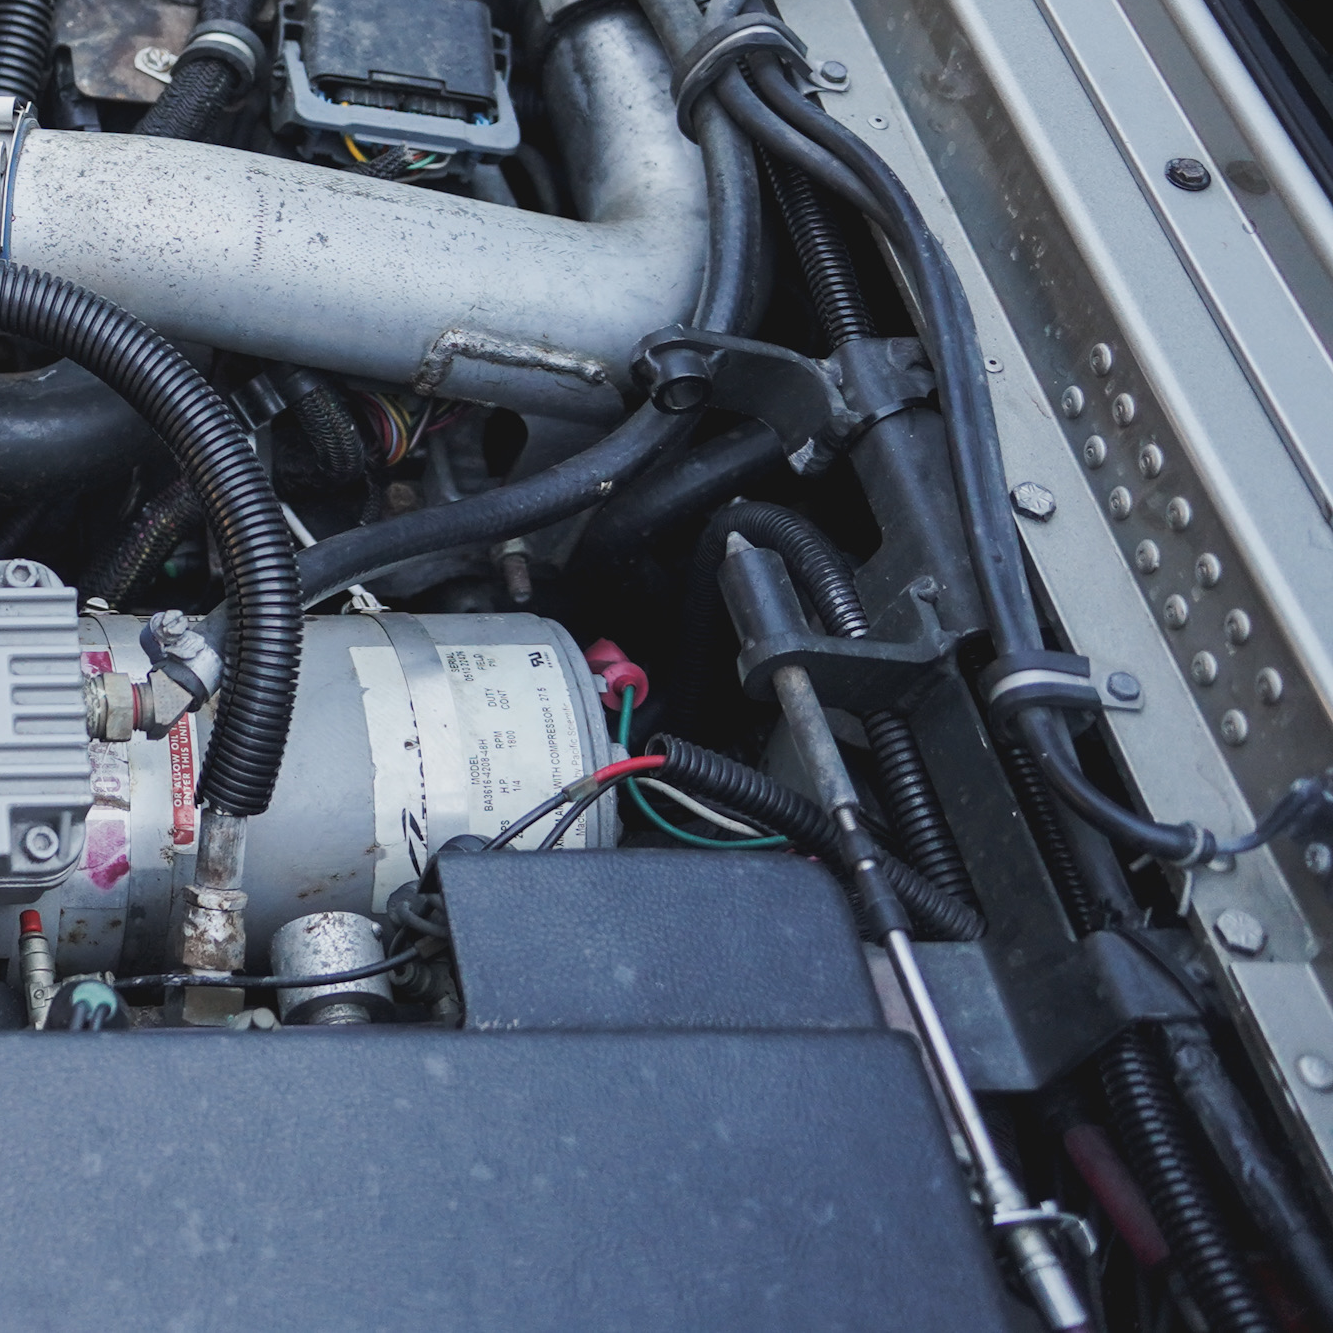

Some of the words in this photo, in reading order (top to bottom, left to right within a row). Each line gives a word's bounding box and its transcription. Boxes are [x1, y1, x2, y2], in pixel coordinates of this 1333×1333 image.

[446, 652, 460, 673] SERIAL
[485, 687, 497, 708] DUTY
[497, 689, 510, 710] CONT
[170, 734, 180, 750] OIL
[178, 720, 189, 743] UNIT
[493, 730, 504, 749] RPM
[506, 730, 517, 749] 1800
[180, 747, 190, 769] THIS
[569, 738, 582, 768] Pacific
[172, 754, 182, 789] ALLOW
[469, 755, 480, 785] MODEL
[552, 767, 563, 788] WITH
[174, 792, 183, 807] OR
[182, 774, 192, 806] ENTER
